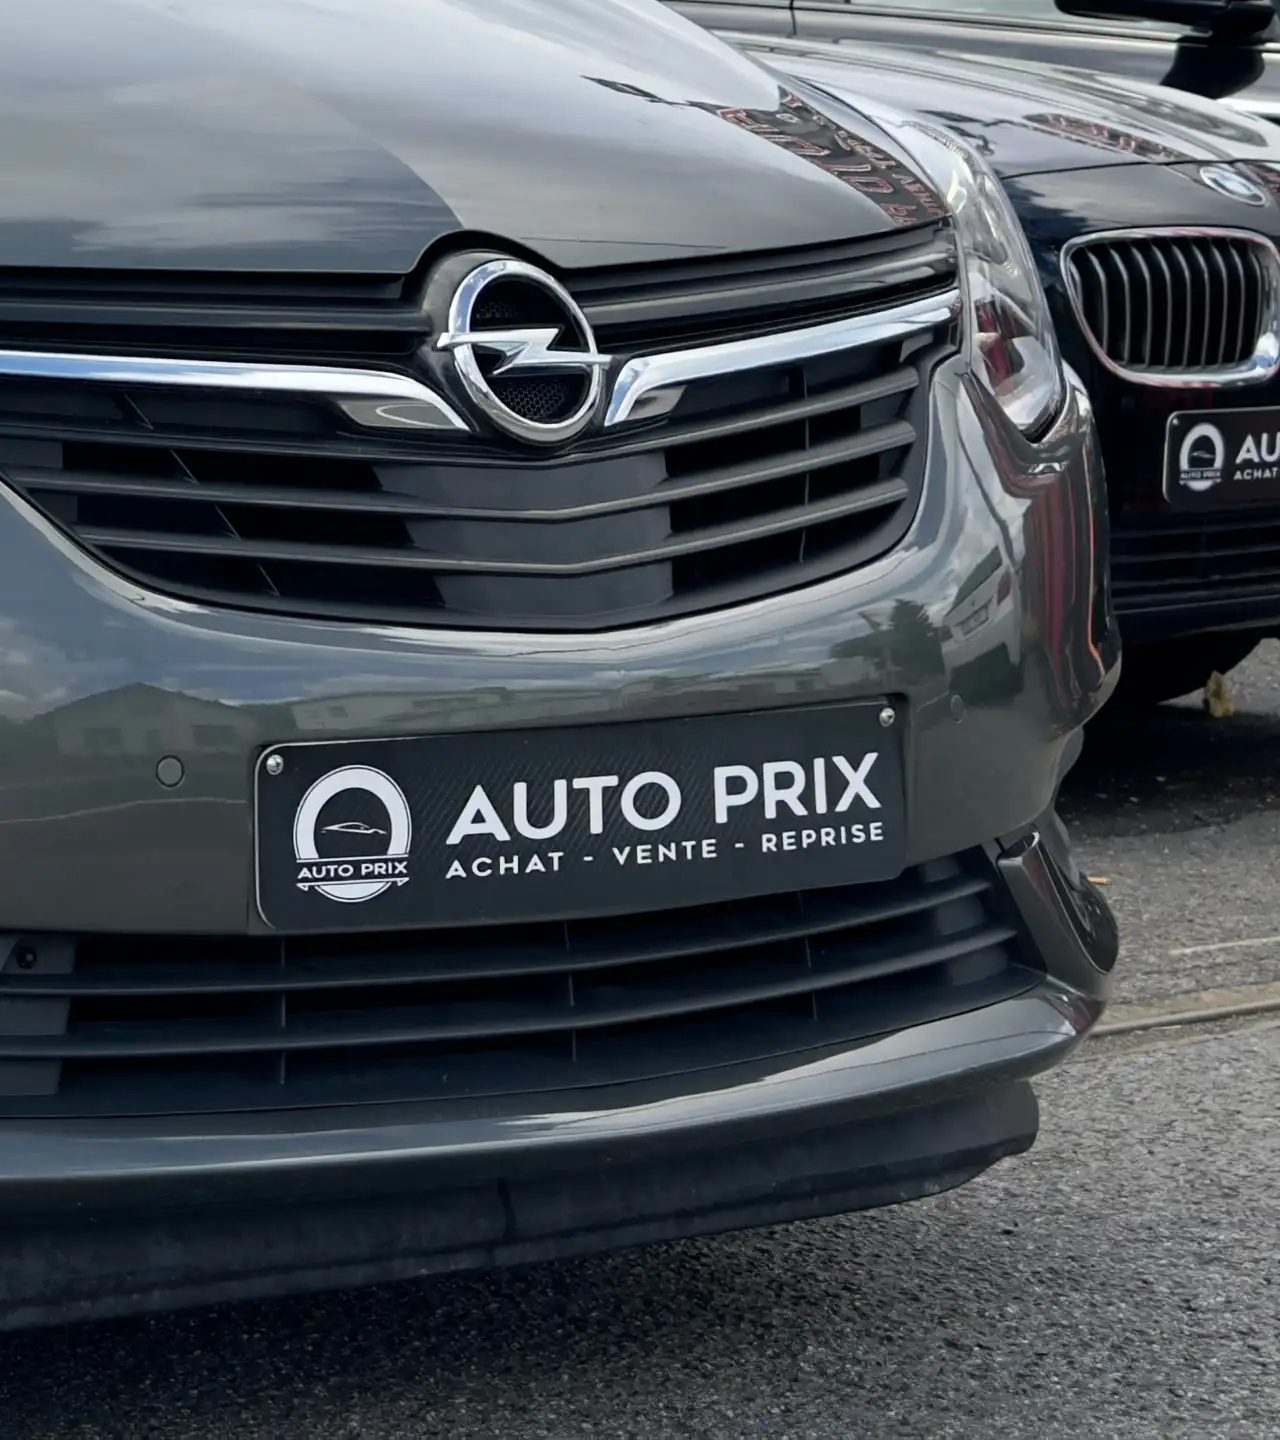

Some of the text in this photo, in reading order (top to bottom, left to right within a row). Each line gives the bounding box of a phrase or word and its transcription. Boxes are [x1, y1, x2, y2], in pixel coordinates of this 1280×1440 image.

[1233, 467, 1278, 480] ACHAT
[445, 751, 882, 845] AUTO PRIX
[445, 851, 564, 880] ACHAT
[611, 838, 718, 866] VENTE
[761, 821, 885, 853] REPRISE
[297, 861, 408, 879] AUTO PRIX
